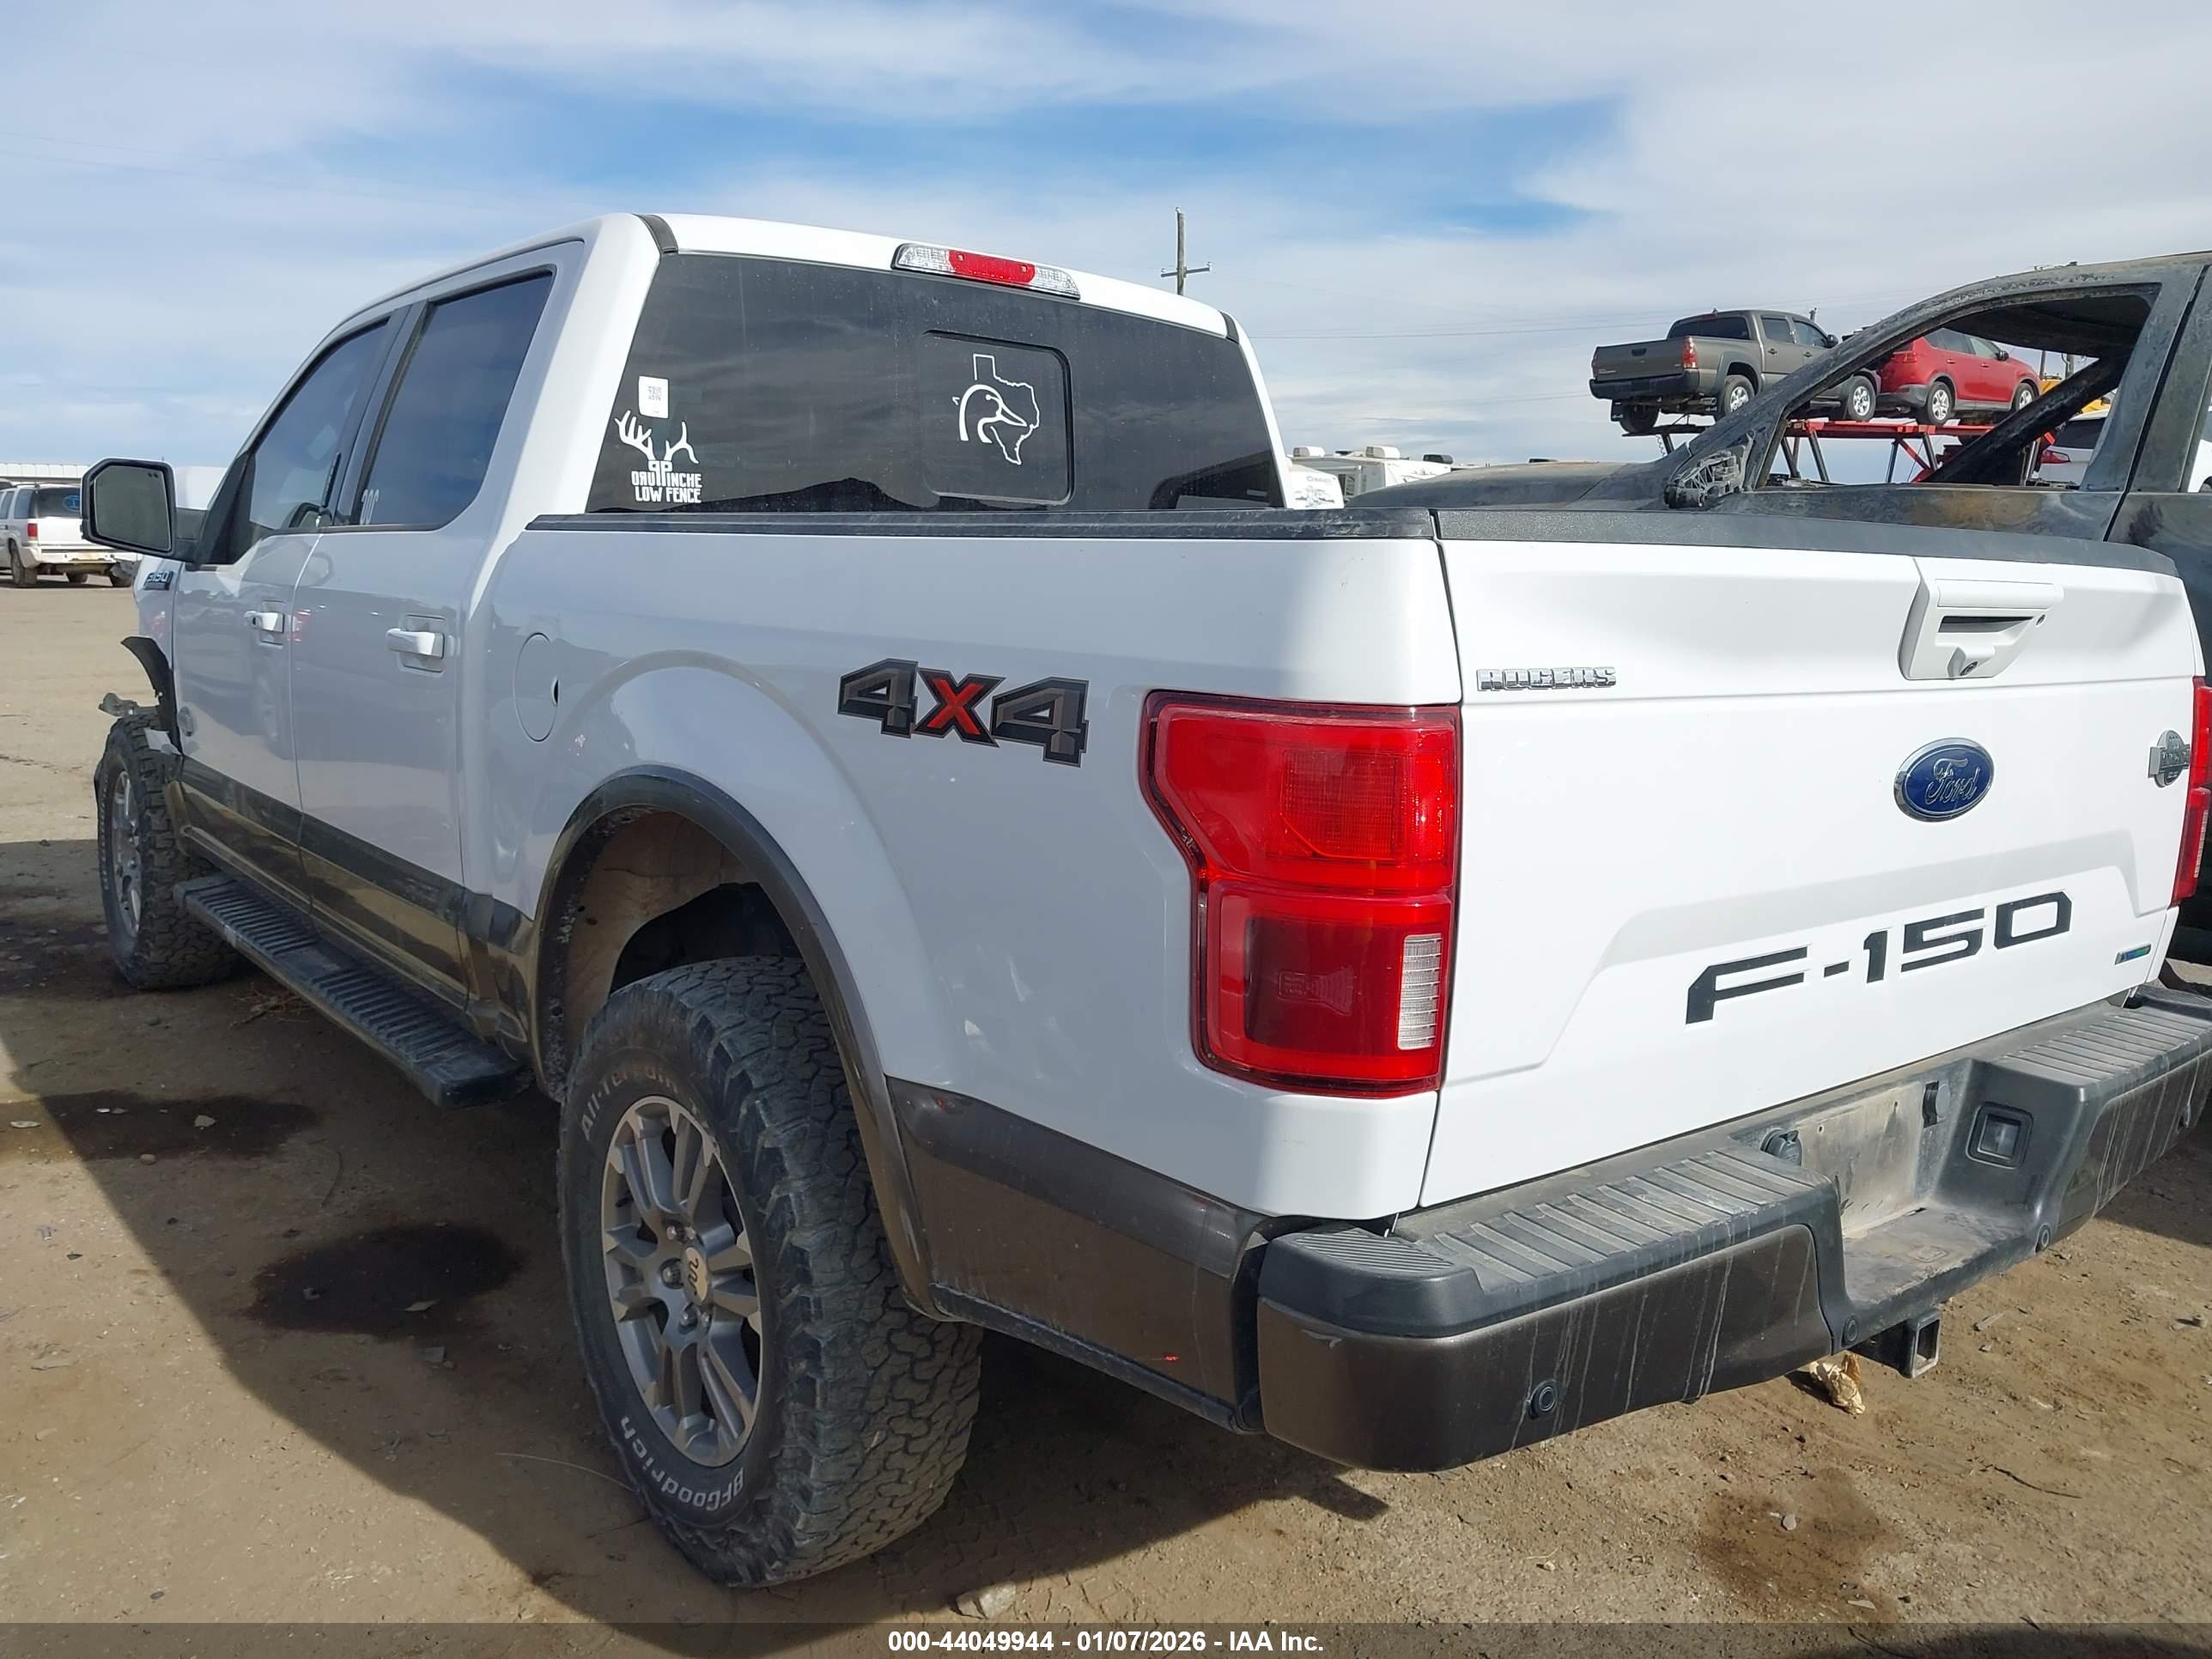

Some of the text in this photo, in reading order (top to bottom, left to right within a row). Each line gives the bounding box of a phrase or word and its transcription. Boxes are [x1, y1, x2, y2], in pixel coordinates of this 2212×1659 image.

[635, 485, 702, 503] LOW FENCE
[1476, 666, 1617, 691] ROGERS
[1924, 757, 1981, 805] Ford
[1686, 890, 2073, 1025] F-150
[620, 1417, 744, 1511] BFGoodrich
